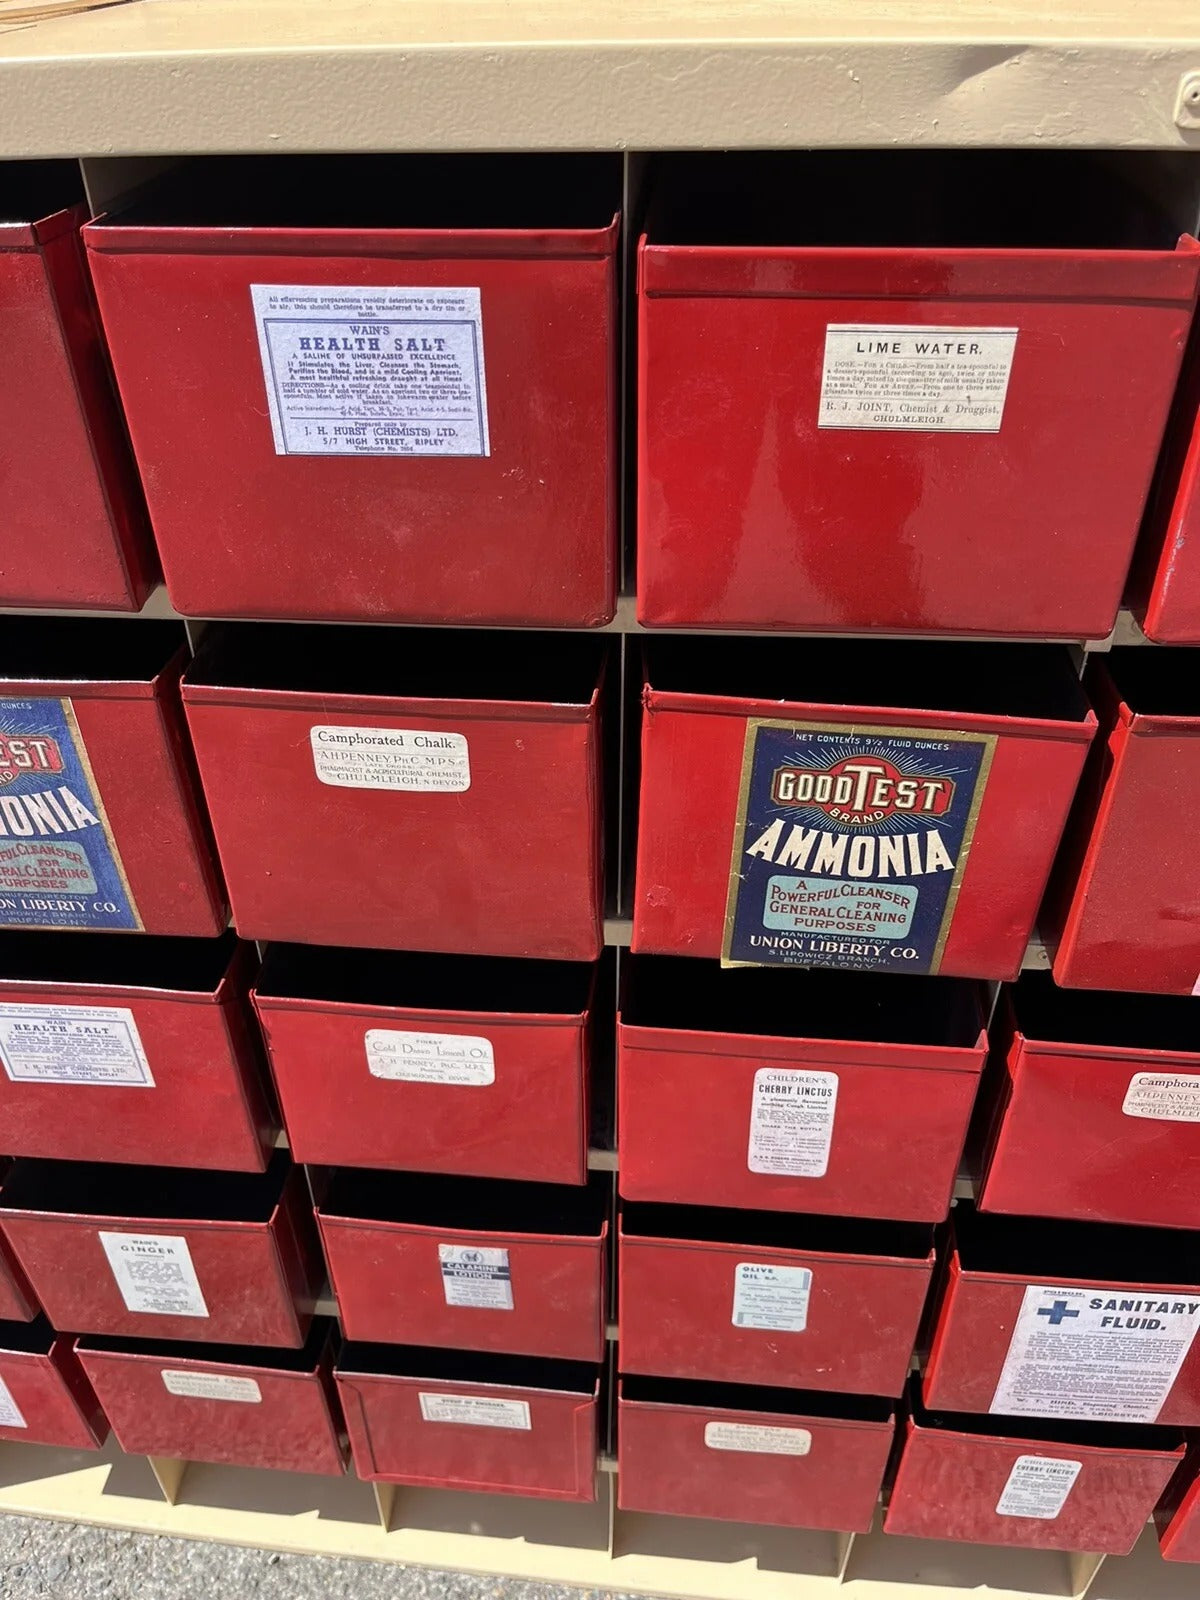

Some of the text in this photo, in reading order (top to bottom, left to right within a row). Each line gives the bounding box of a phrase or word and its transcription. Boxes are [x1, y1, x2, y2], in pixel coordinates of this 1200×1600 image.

[350, 326, 389, 335] WAIN'S
[299, 337, 445, 351] HEALTH SALT
[857, 342, 982, 354] LIME WATER.
[900, 403, 936, 413] Chemist
[943, 405, 949, 413] &
[334, 427, 366, 435] HURST
[373, 427, 430, 437] (CHEMISTS)
[435, 428, 458, 436] LTD.
[318, 731, 456, 749] Camphorated Chalk.
[817, 735, 860, 745] CONTENTS
[888, 739, 911, 748] FLUID
[915, 743, 949, 751] OUNCES
[830, 807, 884, 824] BRAND
[746, 818, 955, 878] AMMONIA
[796, 880, 807, 890] A
[21, 900, 120, 912] LIBERTY CO.
[856, 901, 880, 910] FOR
[794, 918, 876, 932] PURPOSES
[781, 931, 867, 943] MANUFACTURED
[750, 936, 920, 959] UNION LIBERTY CO.
[14, 1024, 68, 1032] HEALTH
[767, 1075, 827, 1084] CHILDREN'S
[759, 1084, 832, 1097] CHERRY LINCTUS
[121, 1245, 175, 1254] GINGER
[447, 1263, 498, 1272] CALAMINE
[454, 1271, 492, 1279] LOTION
[1089, 1298, 1200, 1315] SANITARY
[1101, 1316, 1166, 1330] FLUID.
